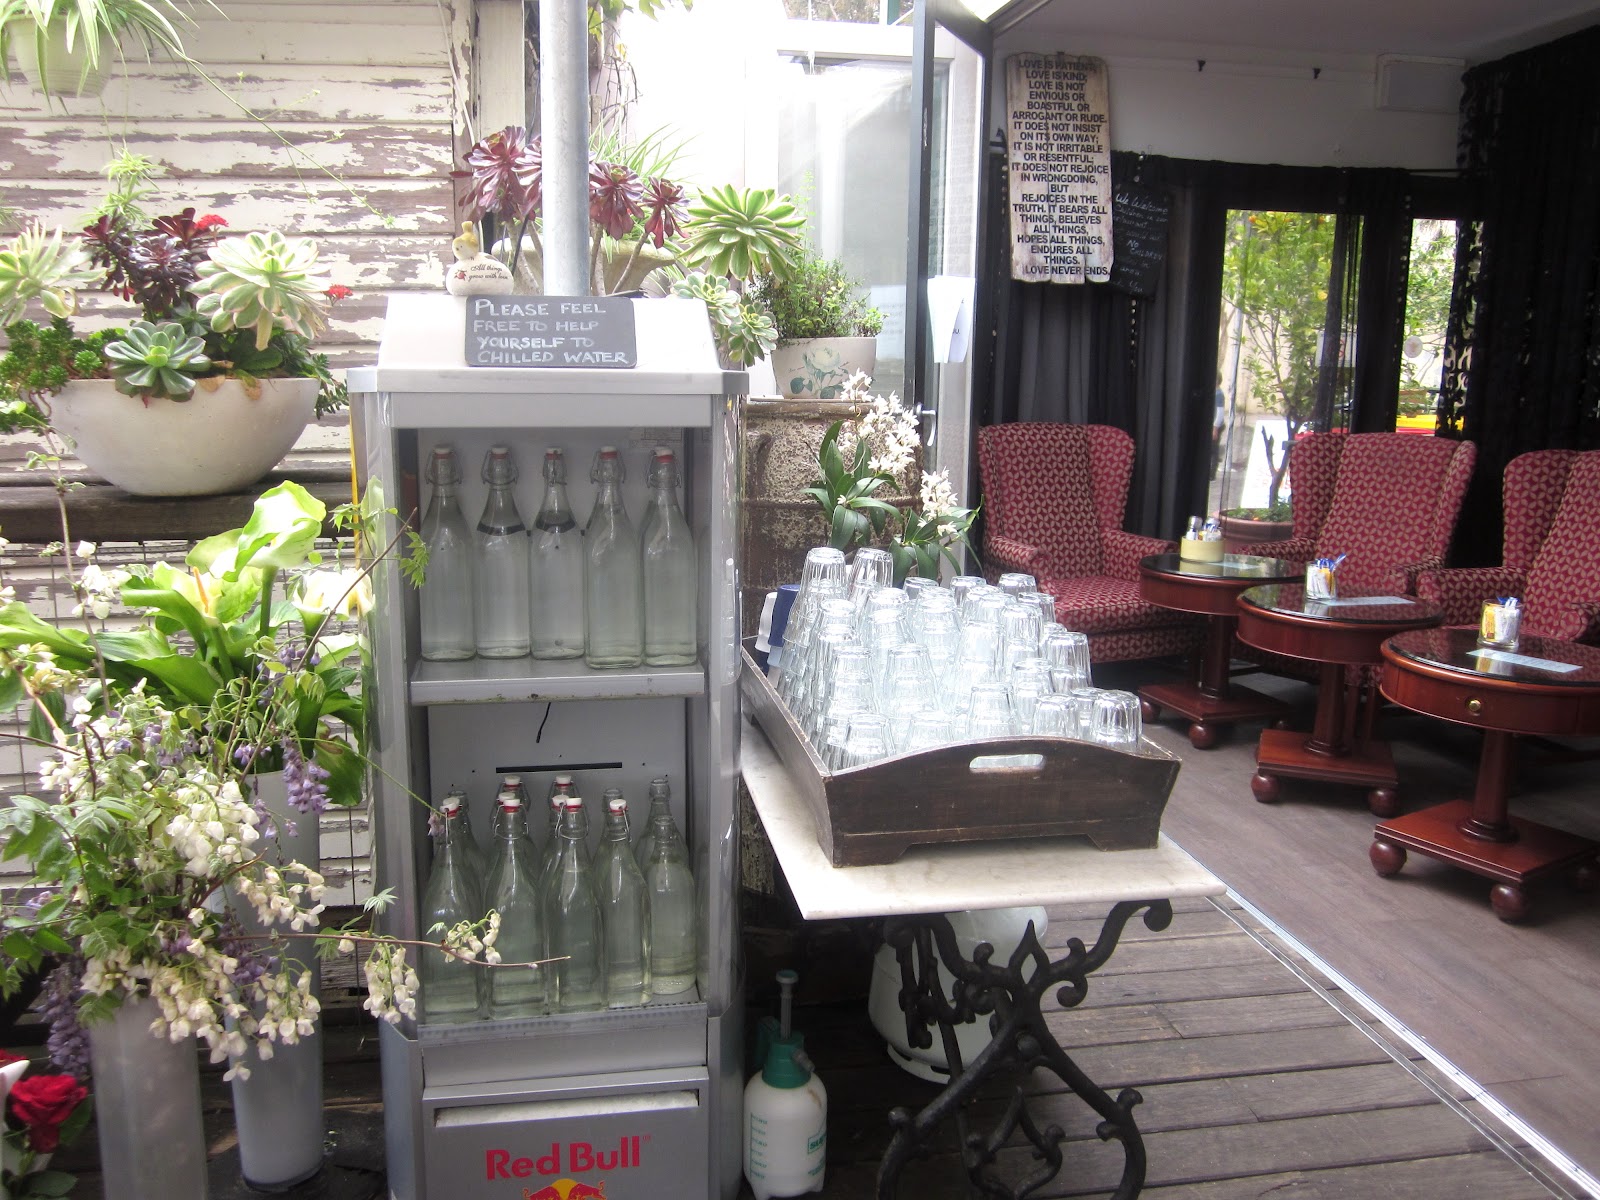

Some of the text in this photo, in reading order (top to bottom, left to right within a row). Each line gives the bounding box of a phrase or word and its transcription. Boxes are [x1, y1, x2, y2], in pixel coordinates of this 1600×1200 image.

[1019, 59, 1042, 68] LOVE
[1044, 60, 1053, 69] IS
[1026, 70, 1087, 82] LOVE IS KIND;
[1029, 80, 1085, 91] LOVE IS NOT
[1030, 91, 1085, 101] ENVIOUS OR
[1027, 101, 1090, 112] BOASTFUL OR
[1012, 111, 1107, 123] ARROGANT OR RUDE.
[1025, 122, 1049, 131] DOES
[1052, 123, 1070, 132] NOT
[1073, 124, 1102, 133] INSIST
[1020, 132, 1099, 144] ON ITS OWN WAY;
[1014, 142, 1103, 153] IT IS NOT IRRITABLE
[1024, 153, 1094, 164] OR RESENTFUL;
[1012, 163, 1108, 174] IT DOES NOT REJOICE
[1021, 174, 1098, 185] IN WRONGDOING,
[1051, 184, 1069, 193] BUT
[1022, 194, 1098, 204] REJOICES IN THE
[1013, 204, 1107, 214] TRUTH. IT BEARS ALL
[1020, 214, 1101, 224] THINGS, BELIEVES
[1033, 225, 1088, 235] ALL THINGS,
[1017, 235, 1105, 246] HOPES ALL THINGS,
[1031, 245, 1092, 254] ENDURES ALL
[1044, 256, 1080, 265] THINGS.
[1025, 266, 1110, 276] LOVE NEVER ENDS.
[475, 298, 606, 316] PLEASE FEEL
[473, 320, 599, 333] FREE TO HELP
[477, 336, 595, 350] YOURSELF TO
[477, 351, 630, 364] CHILLED WATER
[486, 1136, 640, 1180] Red Bull
